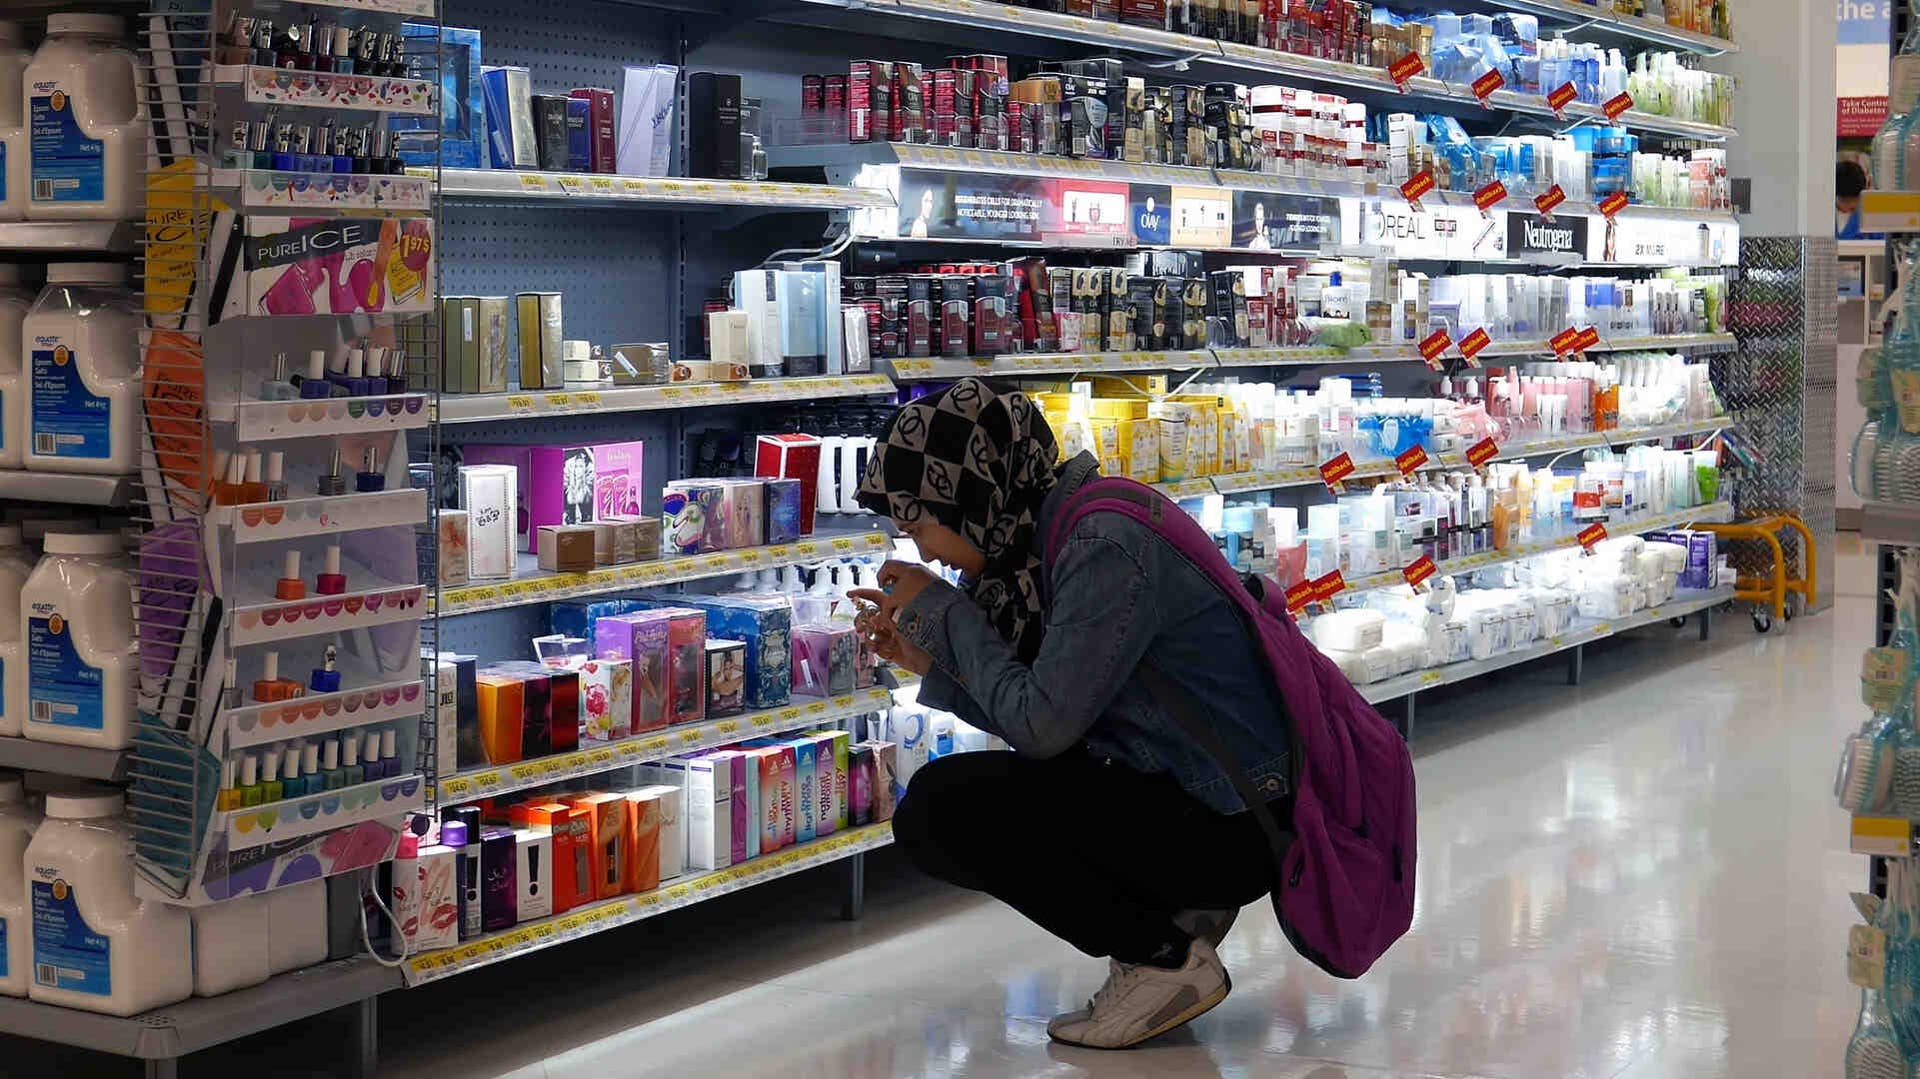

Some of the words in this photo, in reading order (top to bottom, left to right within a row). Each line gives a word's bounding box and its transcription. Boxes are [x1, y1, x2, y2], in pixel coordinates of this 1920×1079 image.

[1837, 0, 1875, 20] the
[1404, 176, 1431, 197] Rollback
[258, 244, 300, 261] PURE
[301, 225, 361, 253] ICE
[1523, 219, 1573, 256] Neutrogena
